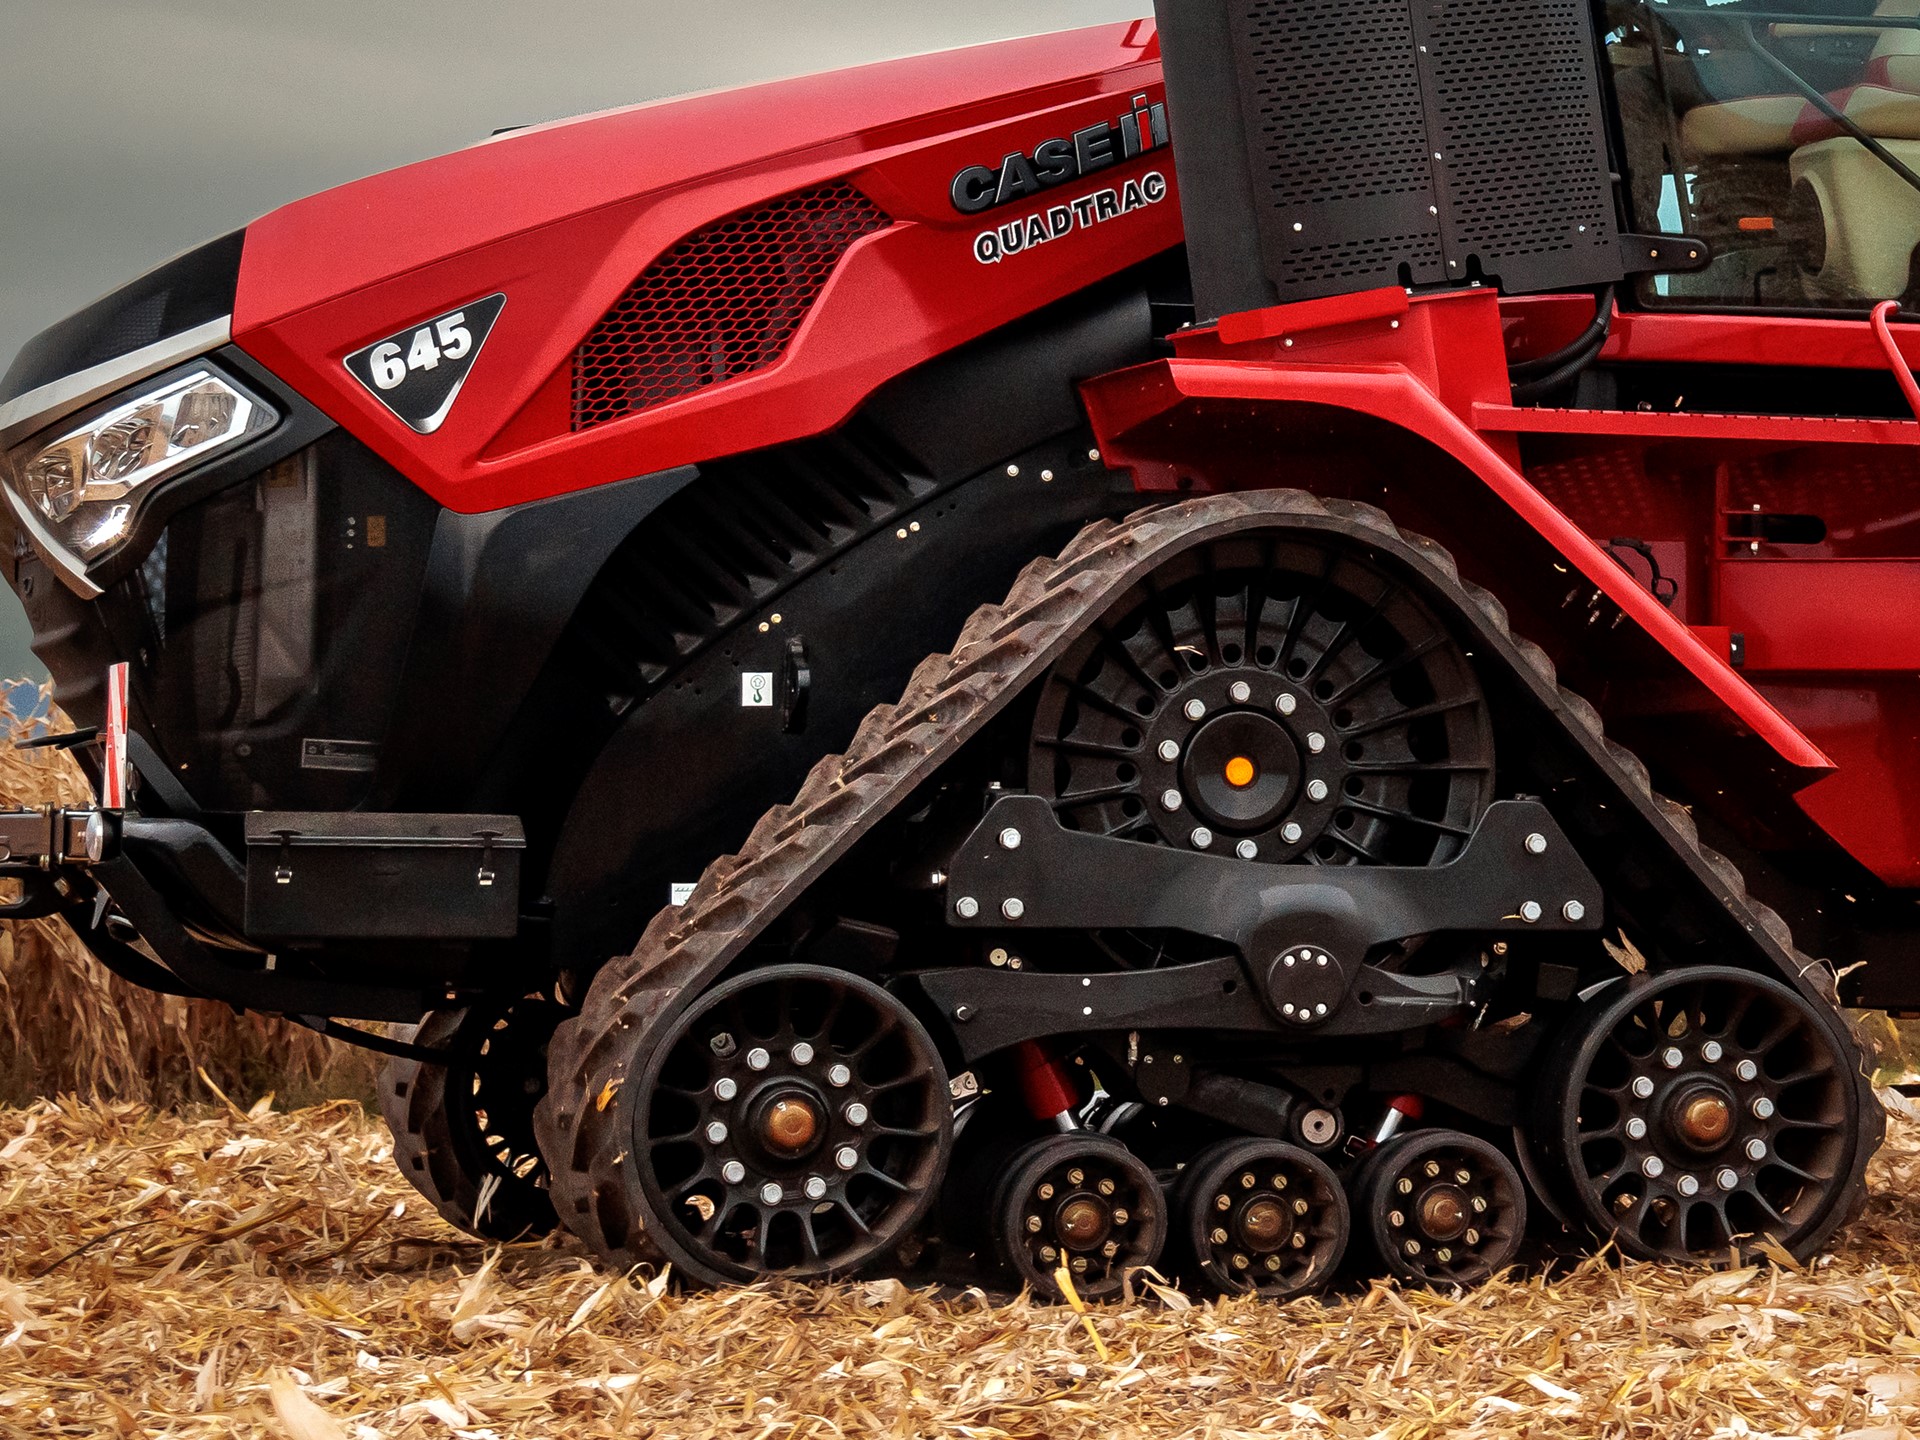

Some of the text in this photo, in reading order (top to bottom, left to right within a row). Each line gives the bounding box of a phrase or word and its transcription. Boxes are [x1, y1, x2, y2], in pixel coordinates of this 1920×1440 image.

[950, 121, 1114, 214] CASE
[973, 171, 1167, 265] QUADTRAC
[370, 312, 472, 390] 645
